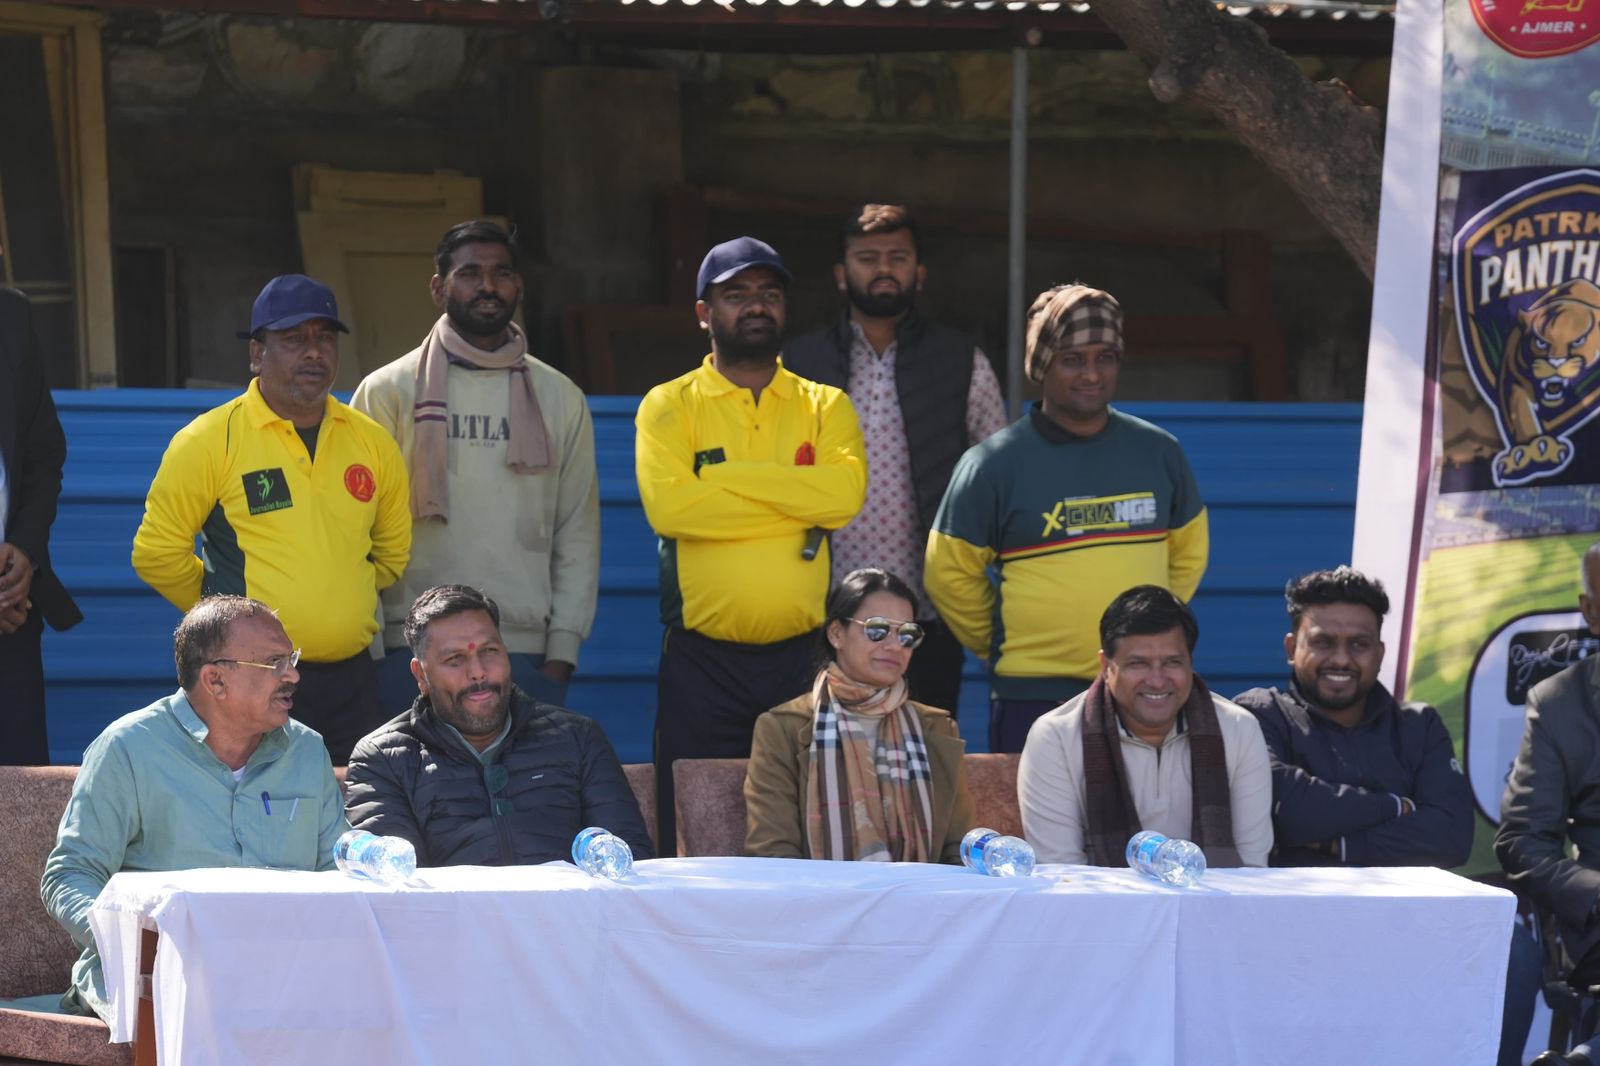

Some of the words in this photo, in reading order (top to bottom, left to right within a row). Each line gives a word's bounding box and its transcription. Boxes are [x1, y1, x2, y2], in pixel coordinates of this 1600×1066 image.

[1521, 21, 1575, 34] AJMER
[1480, 240, 1600, 305] PANTH
[447, 413, 510, 440] LTLA
